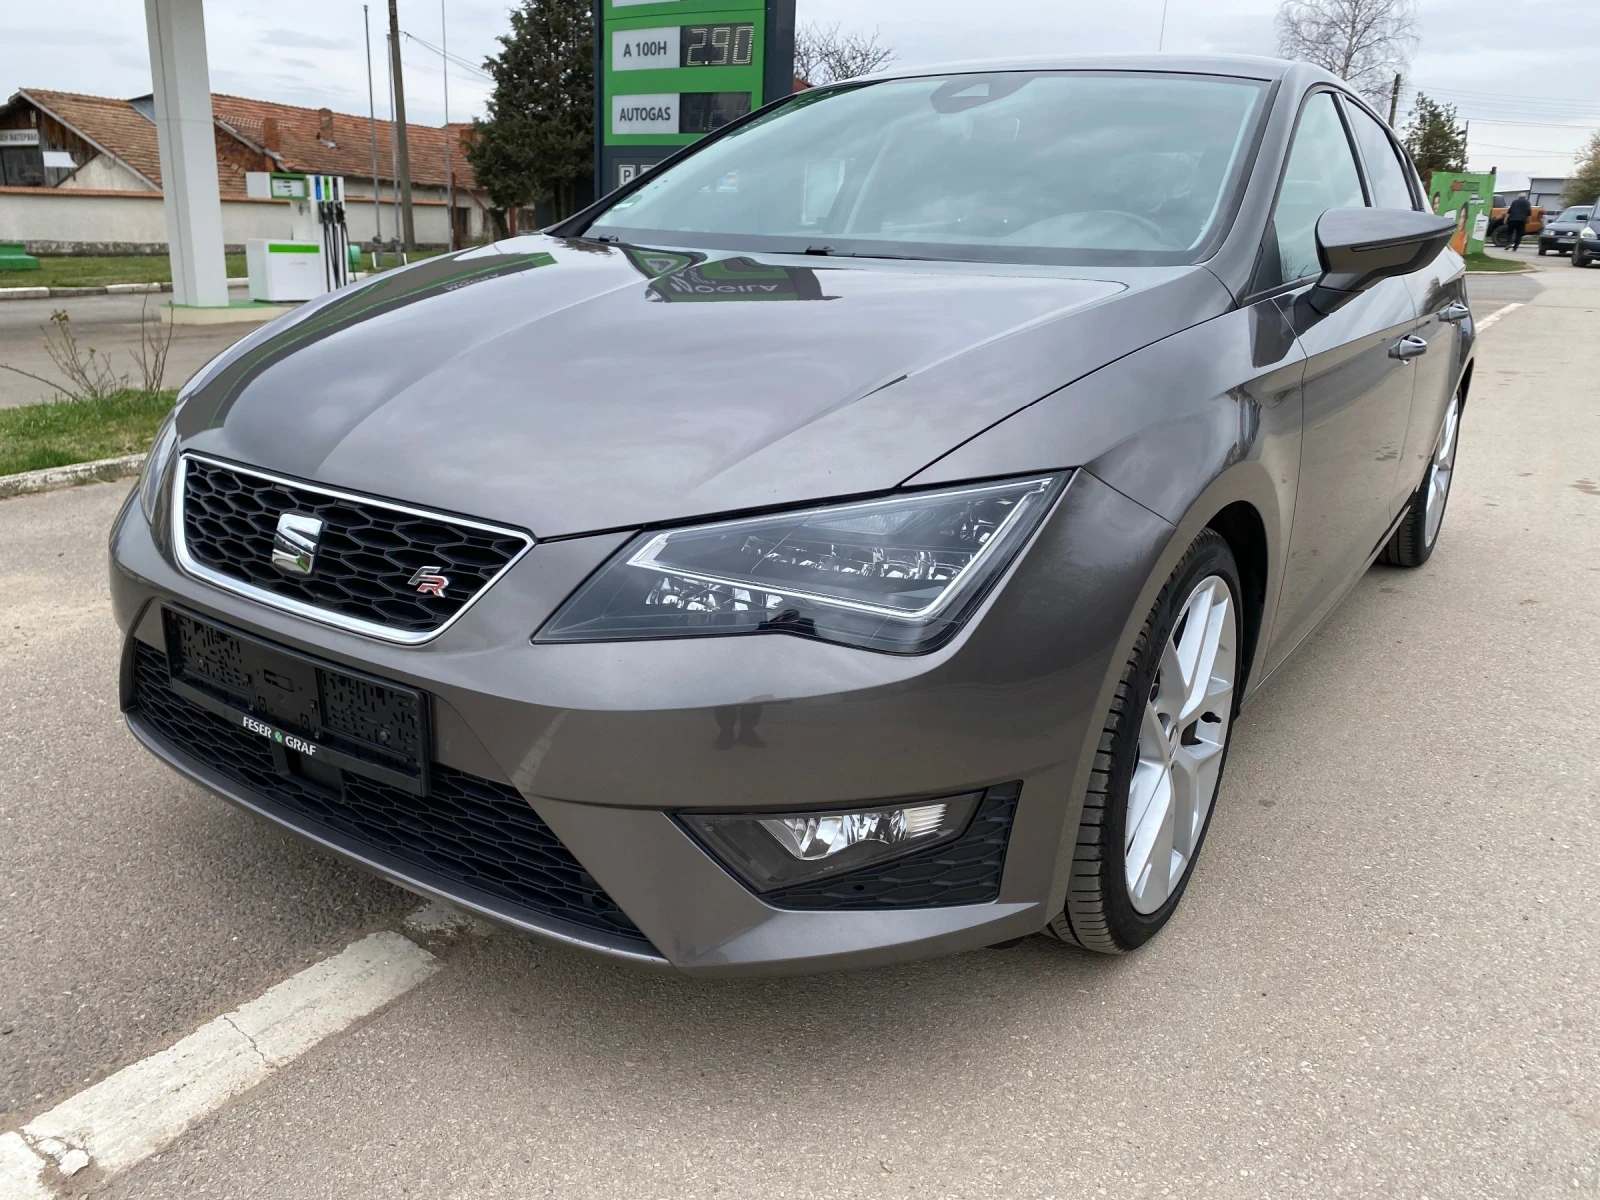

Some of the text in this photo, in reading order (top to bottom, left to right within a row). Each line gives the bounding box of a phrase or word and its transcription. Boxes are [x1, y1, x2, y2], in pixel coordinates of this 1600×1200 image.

[623, 41, 667, 57] A 100H
[686, 26, 754, 66] 2.90
[620, 107, 671, 122] AUTOGAS
[623, 170, 631, 182] P
[407, 566, 449, 598] FR
[243, 716, 316, 756] FESER GRAF
